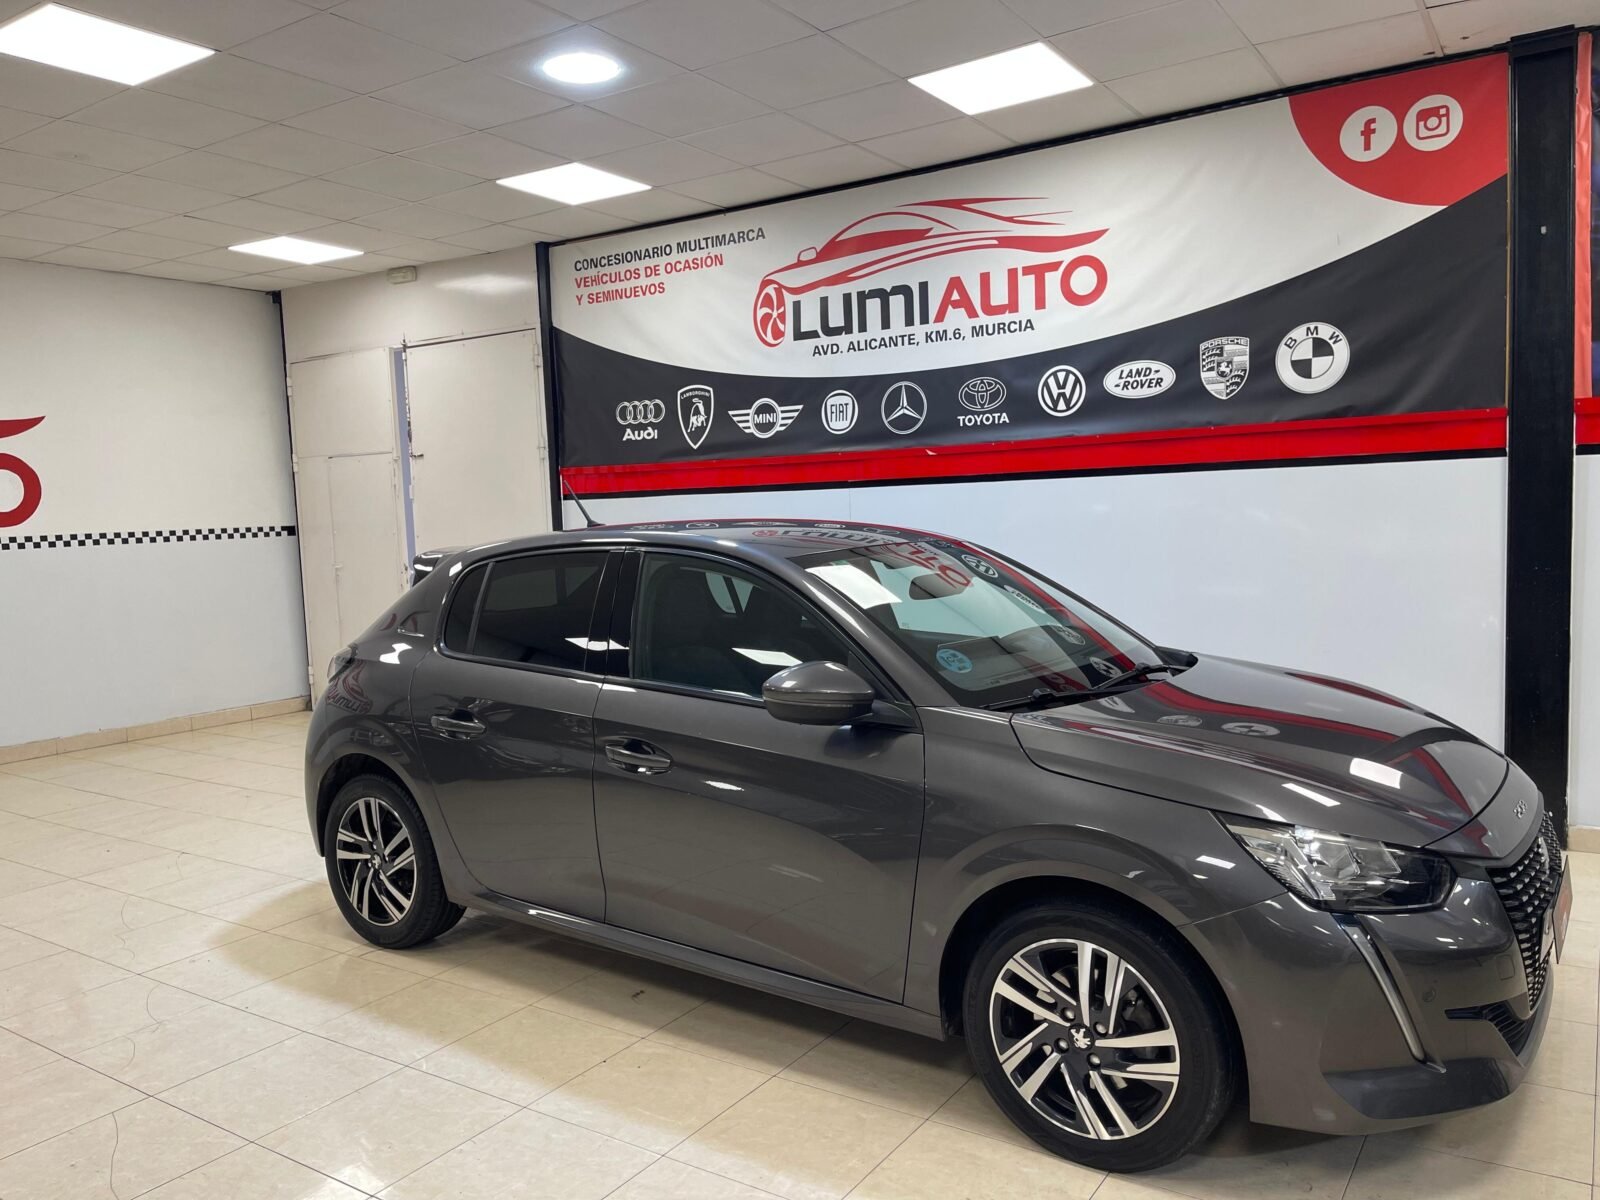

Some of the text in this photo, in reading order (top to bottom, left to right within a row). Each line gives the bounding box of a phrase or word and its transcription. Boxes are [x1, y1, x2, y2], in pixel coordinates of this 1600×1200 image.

[574, 227, 766, 272] CONCESIONARIO MULTIMARCA
[575, 252, 724, 289] VEHÍCULOS DE OCASIÓN
[576, 281, 665, 306] Y SEMINUEVOS
[812, 318, 1036, 357] AVD. ALICANTE, KM.6, MURCIA
[1200, 336, 1248, 350] PORSCHE
[1284, 325, 1343, 350] BMW
[754, 412, 777, 425] MINI
[830, 402, 850, 423] FIAT
[957, 412, 1010, 427] TOYOTA
[622, 426, 658, 441] Audi
